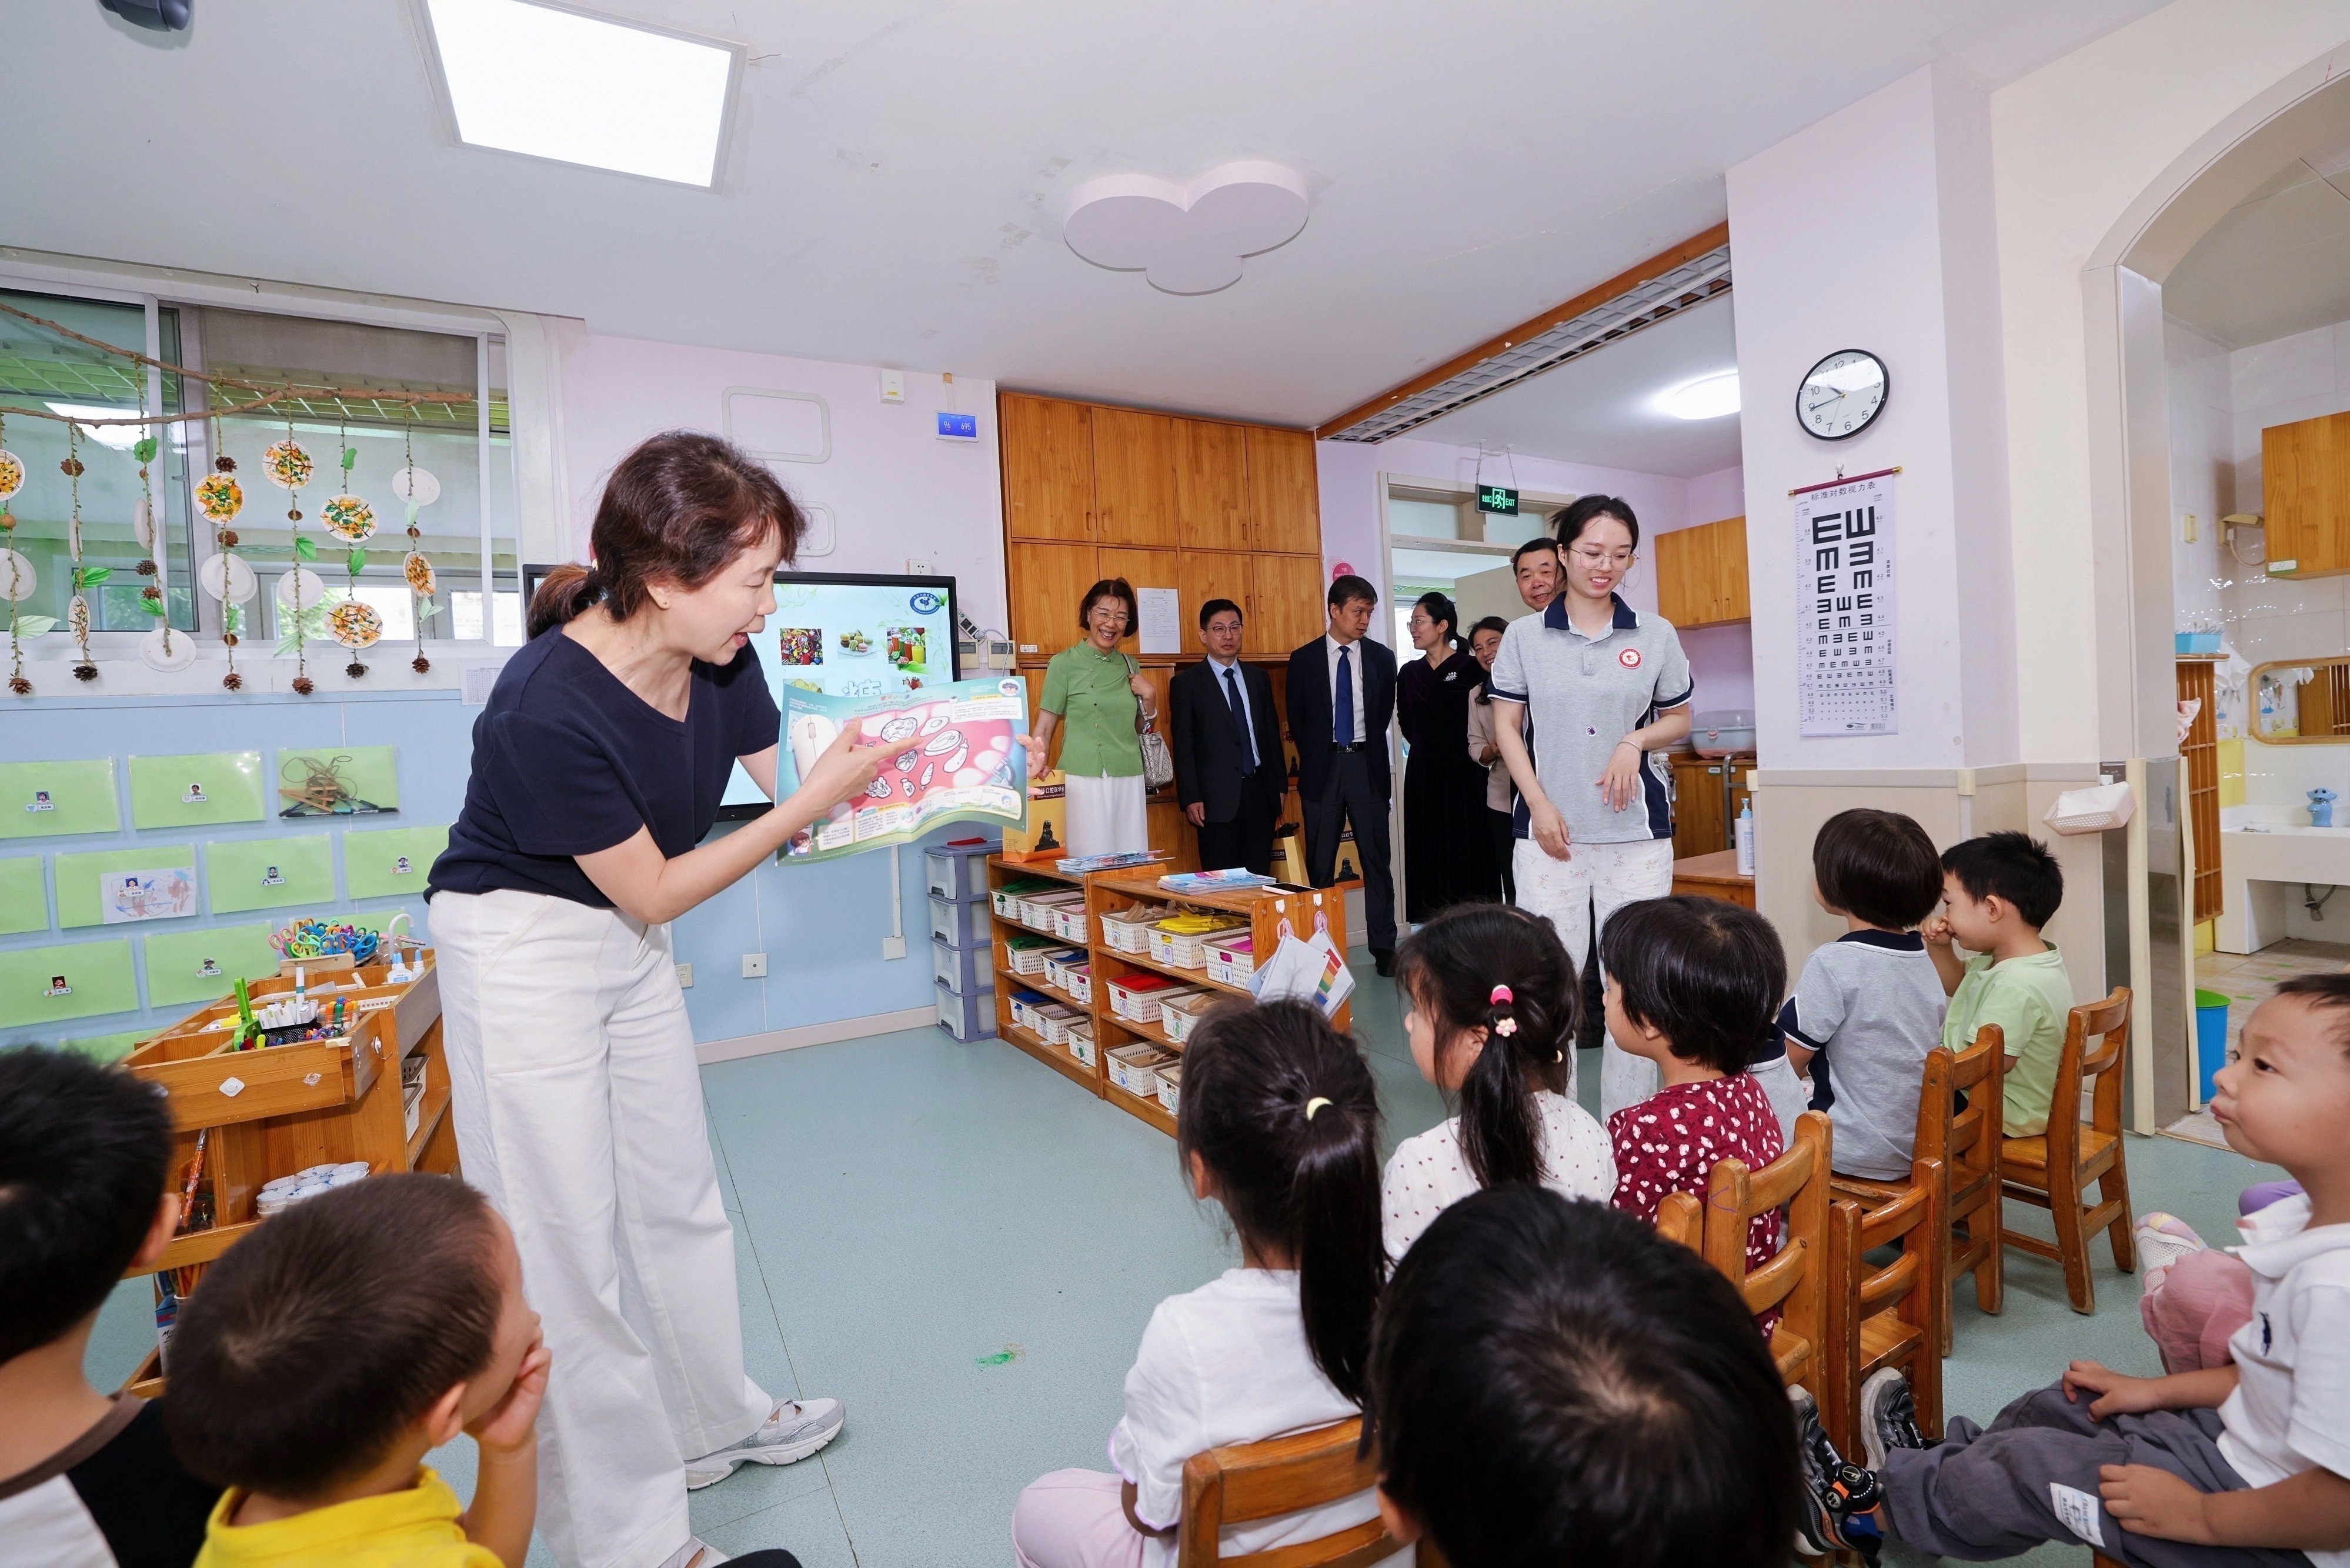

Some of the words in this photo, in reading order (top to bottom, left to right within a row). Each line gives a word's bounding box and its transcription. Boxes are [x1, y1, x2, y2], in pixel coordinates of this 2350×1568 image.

[1834, 361, 1845, 369] 12
[1810, 385, 1820, 396] 10
[1871, 395, 1878, 405] 4
[1808, 402, 1815, 412] 9
[1815, 414, 1822, 423] 8
[1861, 410, 1870, 420] 5
[943, 421, 951, 429] 96
[961, 422, 971, 431] 695
[1826, 422, 1833, 432] 7
[1844, 421, 1852, 431] 6
[1811, 481, 1876, 502] 标准对数视力表
[1506, 498, 1515, 506] EXIT
